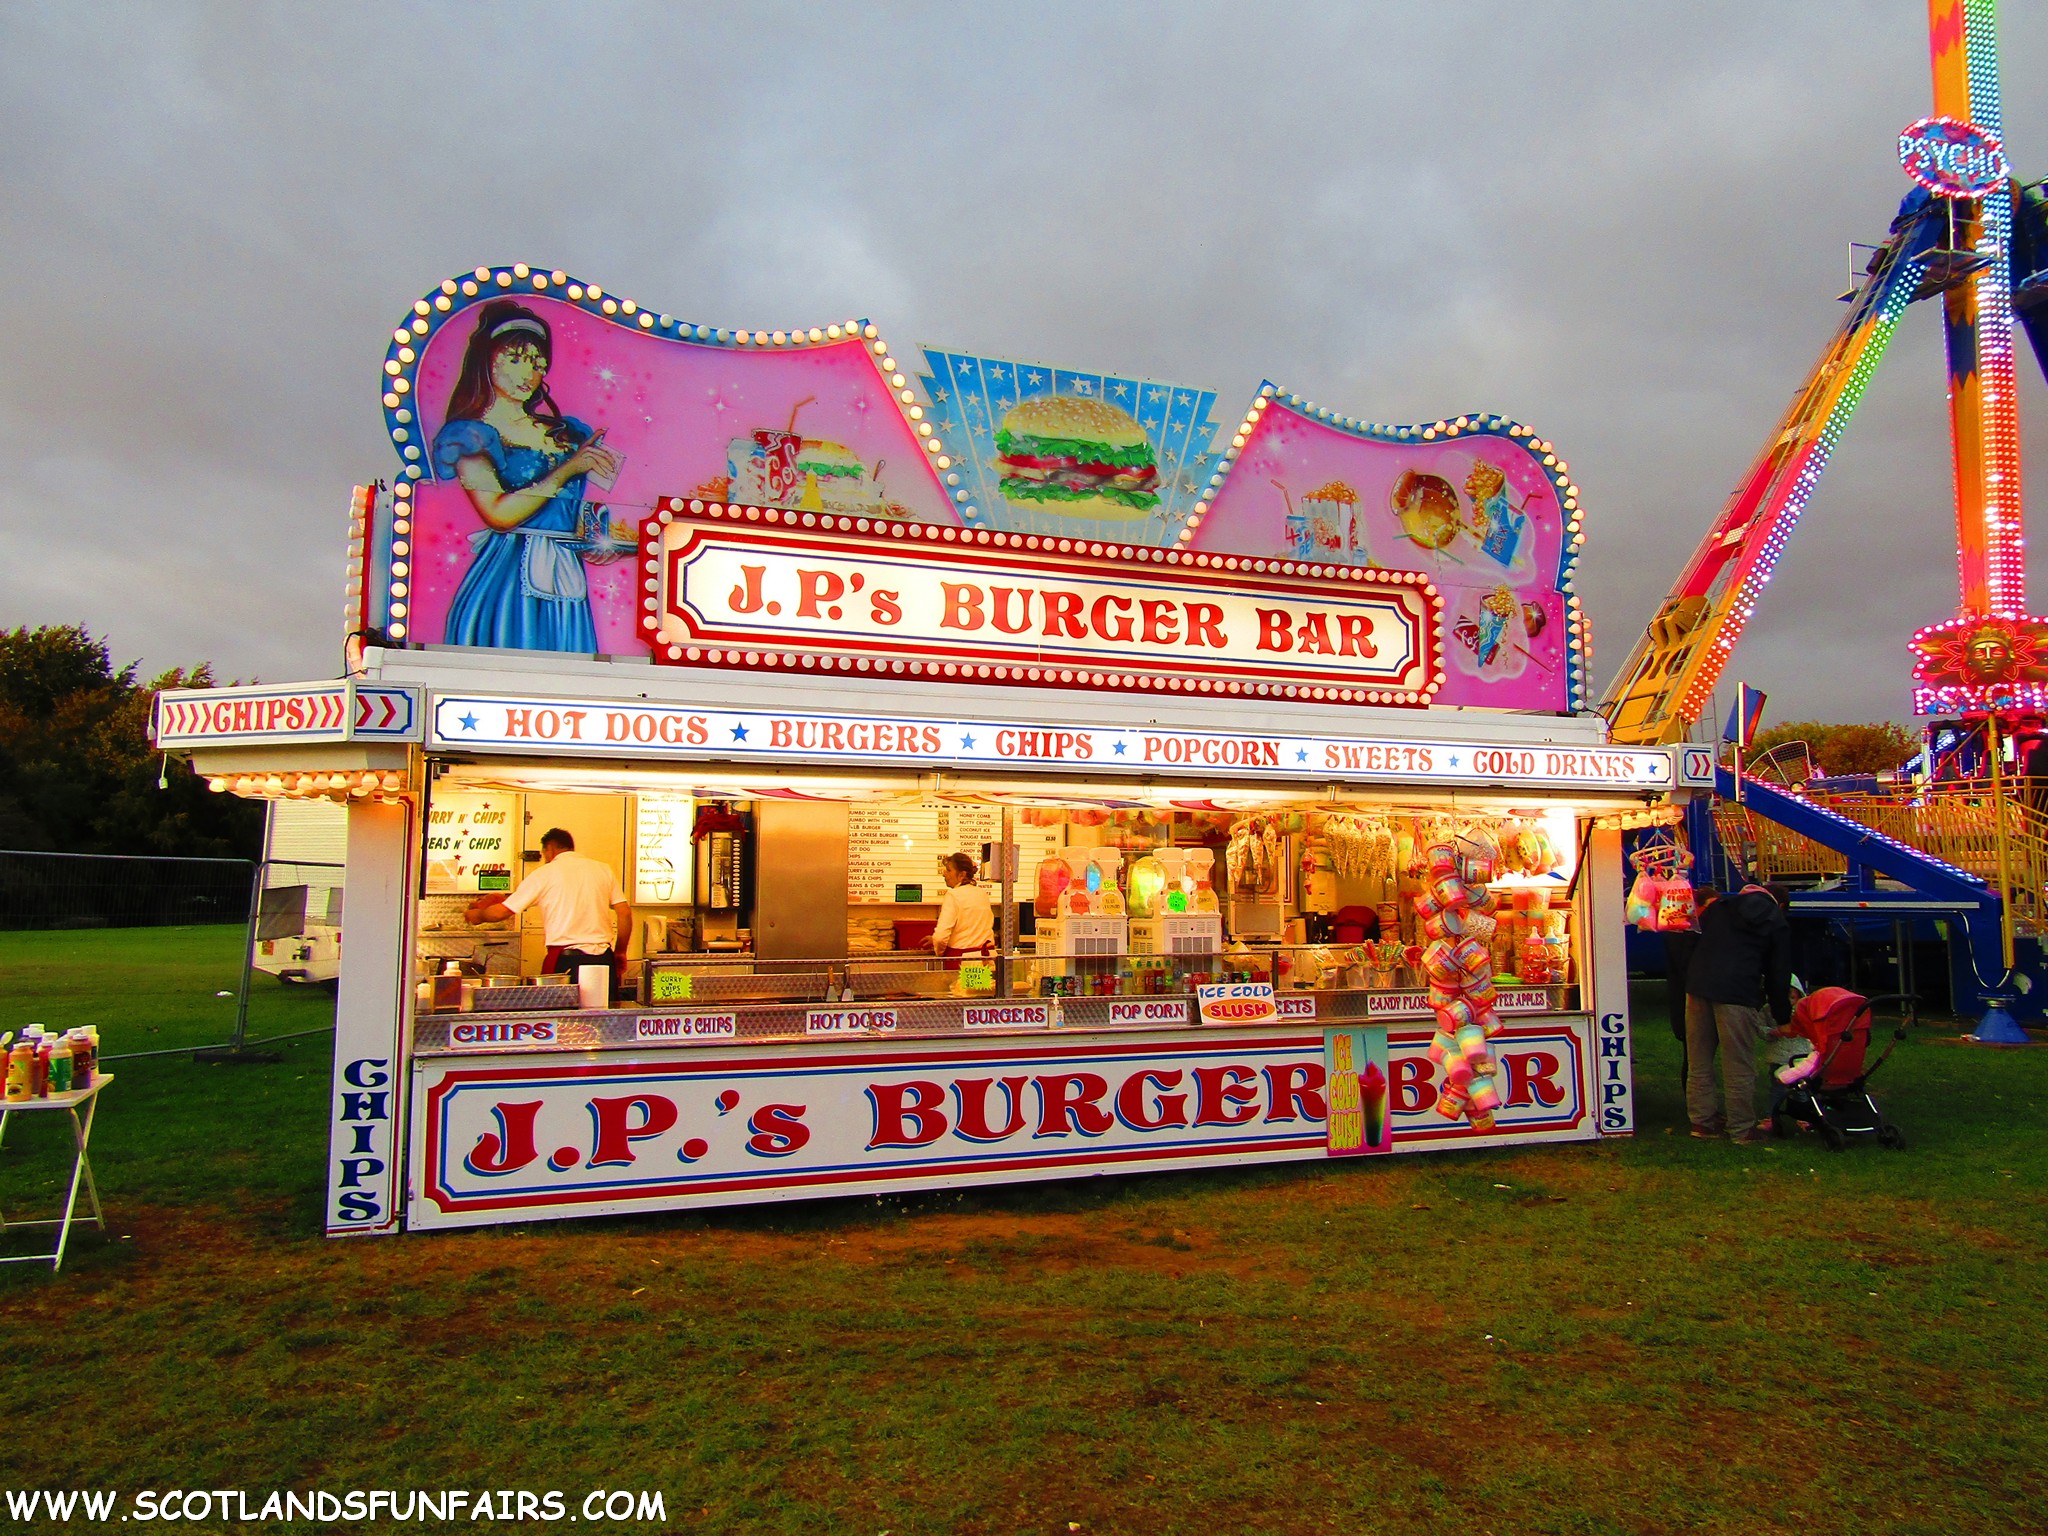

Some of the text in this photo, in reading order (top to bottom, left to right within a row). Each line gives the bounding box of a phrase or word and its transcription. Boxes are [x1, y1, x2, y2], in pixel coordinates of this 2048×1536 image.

[1899, 135, 2009, 178] PSYCHO
[728, 565, 1378, 659] J.P.'s BURGER BAR
[1915, 683, 2048, 712] PSYCH
[212, 698, 304, 733] CHIPS
[504, 708, 709, 745] HOT DOGS
[769, 720, 942, 754] BURGERS
[996, 730, 1092, 759] CHIPS
[1143, 736, 1280, 766] POPCORN
[1325, 744, 1433, 772] SWEETS
[1473, 751, 1635, 778] COLD DRINKS
[473, 811, 506, 824] CHIPS
[428, 837, 451, 850] EAS
[469, 837, 501, 850] CHIPS
[1199, 986, 1272, 998] ICE COLD
[1370, 996, 1400, 1010] CANDY
[1515, 993, 1544, 1006] APPLES
[809, 1011, 896, 1031] HOT DOGS
[966, 1007, 1046, 1025] BURGERS
[1112, 1003, 1185, 1019] POP CORN
[1210, 1003, 1268, 1017] SLUSH
[453, 1022, 554, 1043] CHIPS
[639, 1016, 733, 1035] CURRY & CHIPS
[1332, 1034, 1352, 1072] ICE
[1600, 1013, 1627, 1128] CHIPS
[863, 1062, 1327, 1152] BURGER
[1386, 1050, 1566, 1117] BR
[1329, 1072, 1359, 1111] COLD
[338, 1059, 390, 1221] CHIPS
[1329, 1111, 1362, 1150] SLUSH
